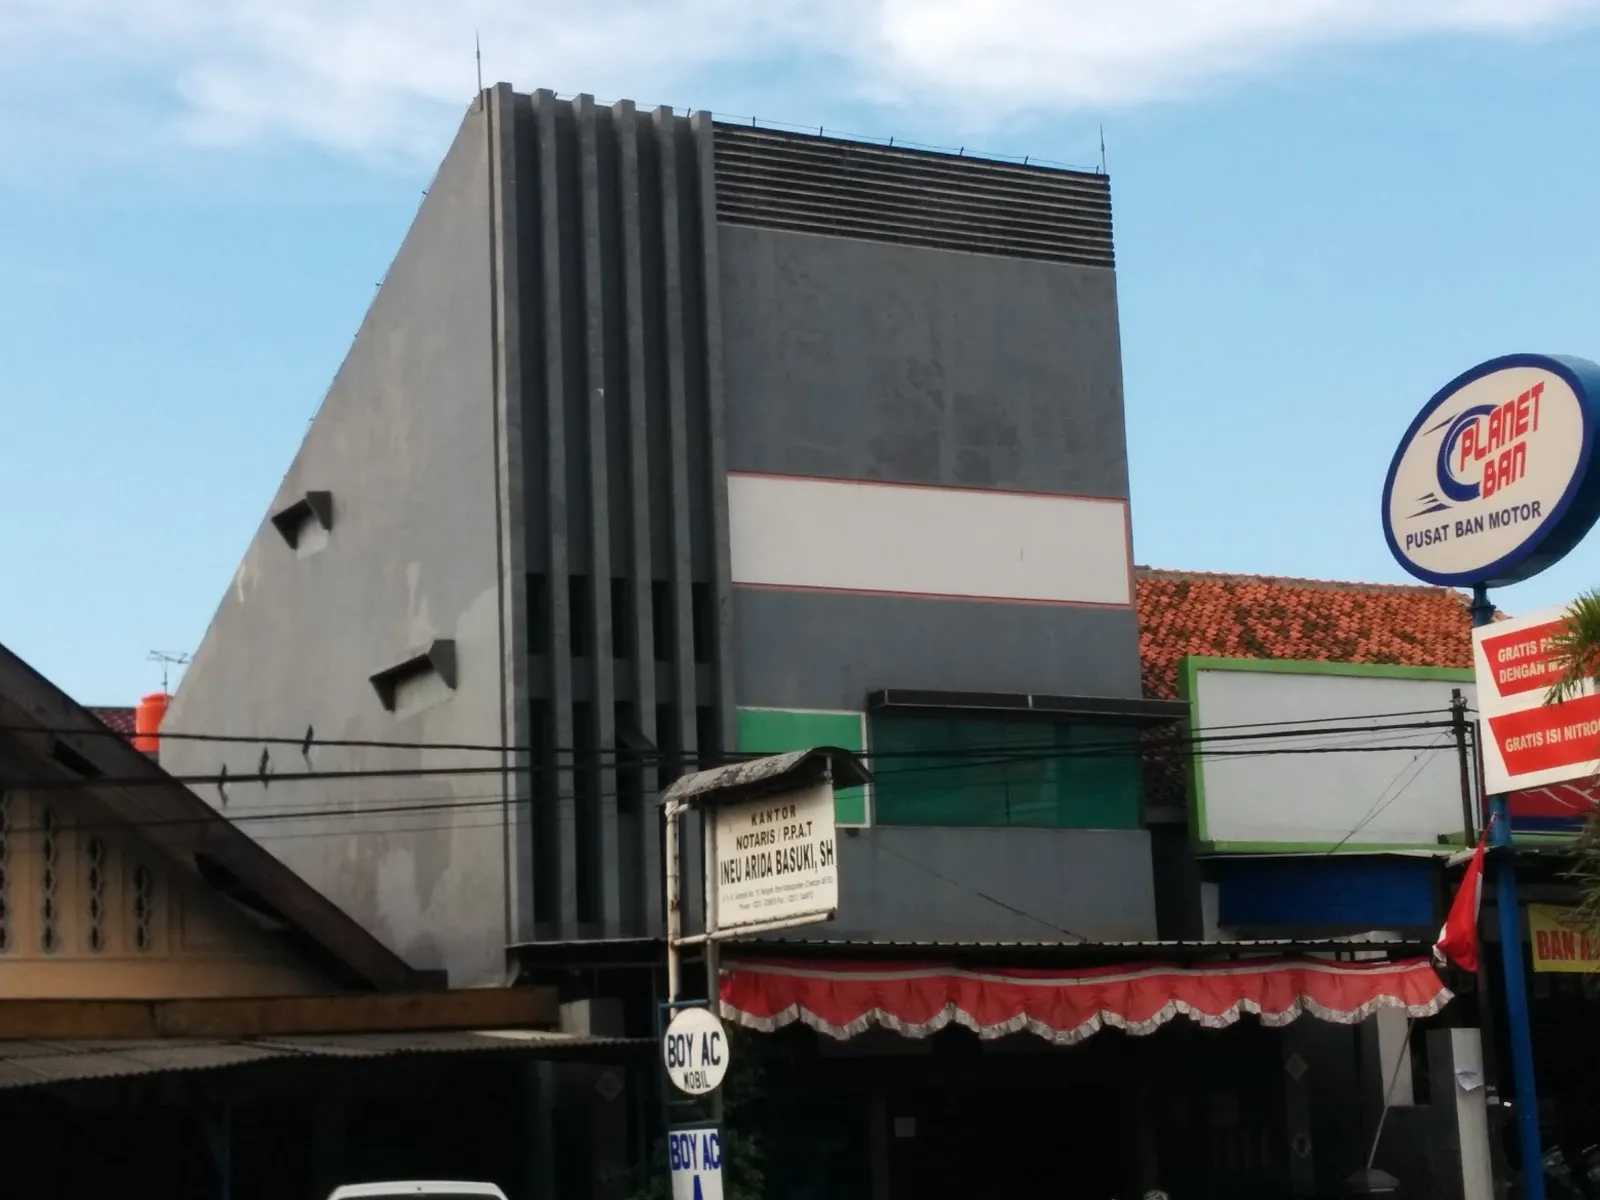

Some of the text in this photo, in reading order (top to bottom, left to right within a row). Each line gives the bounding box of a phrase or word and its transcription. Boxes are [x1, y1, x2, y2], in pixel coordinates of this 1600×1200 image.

[1460, 381, 1544, 473] PLANET
[1482, 441, 1527, 500] BAN
[1406, 500, 1541, 551] PUSAT BAN MOTOR
[1498, 641, 1537, 662] GRATIS
[1499, 662, 1545, 683] DENGAN
[1505, 718, 1600, 752] GRATIS ISI NITRO
[751, 805, 796, 826] KANTOR
[736, 829, 775, 851] NOTARIS
[783, 821, 812, 841] P.P.A.T
[720, 839, 834, 886] INEU ARIDA BASUKI, SH
[1536, 930, 1575, 960] BAN
[668, 1031, 721, 1068] BOY AC
[683, 1070, 711, 1091] MOBIL
[669, 1132, 721, 1171] BOY AC
